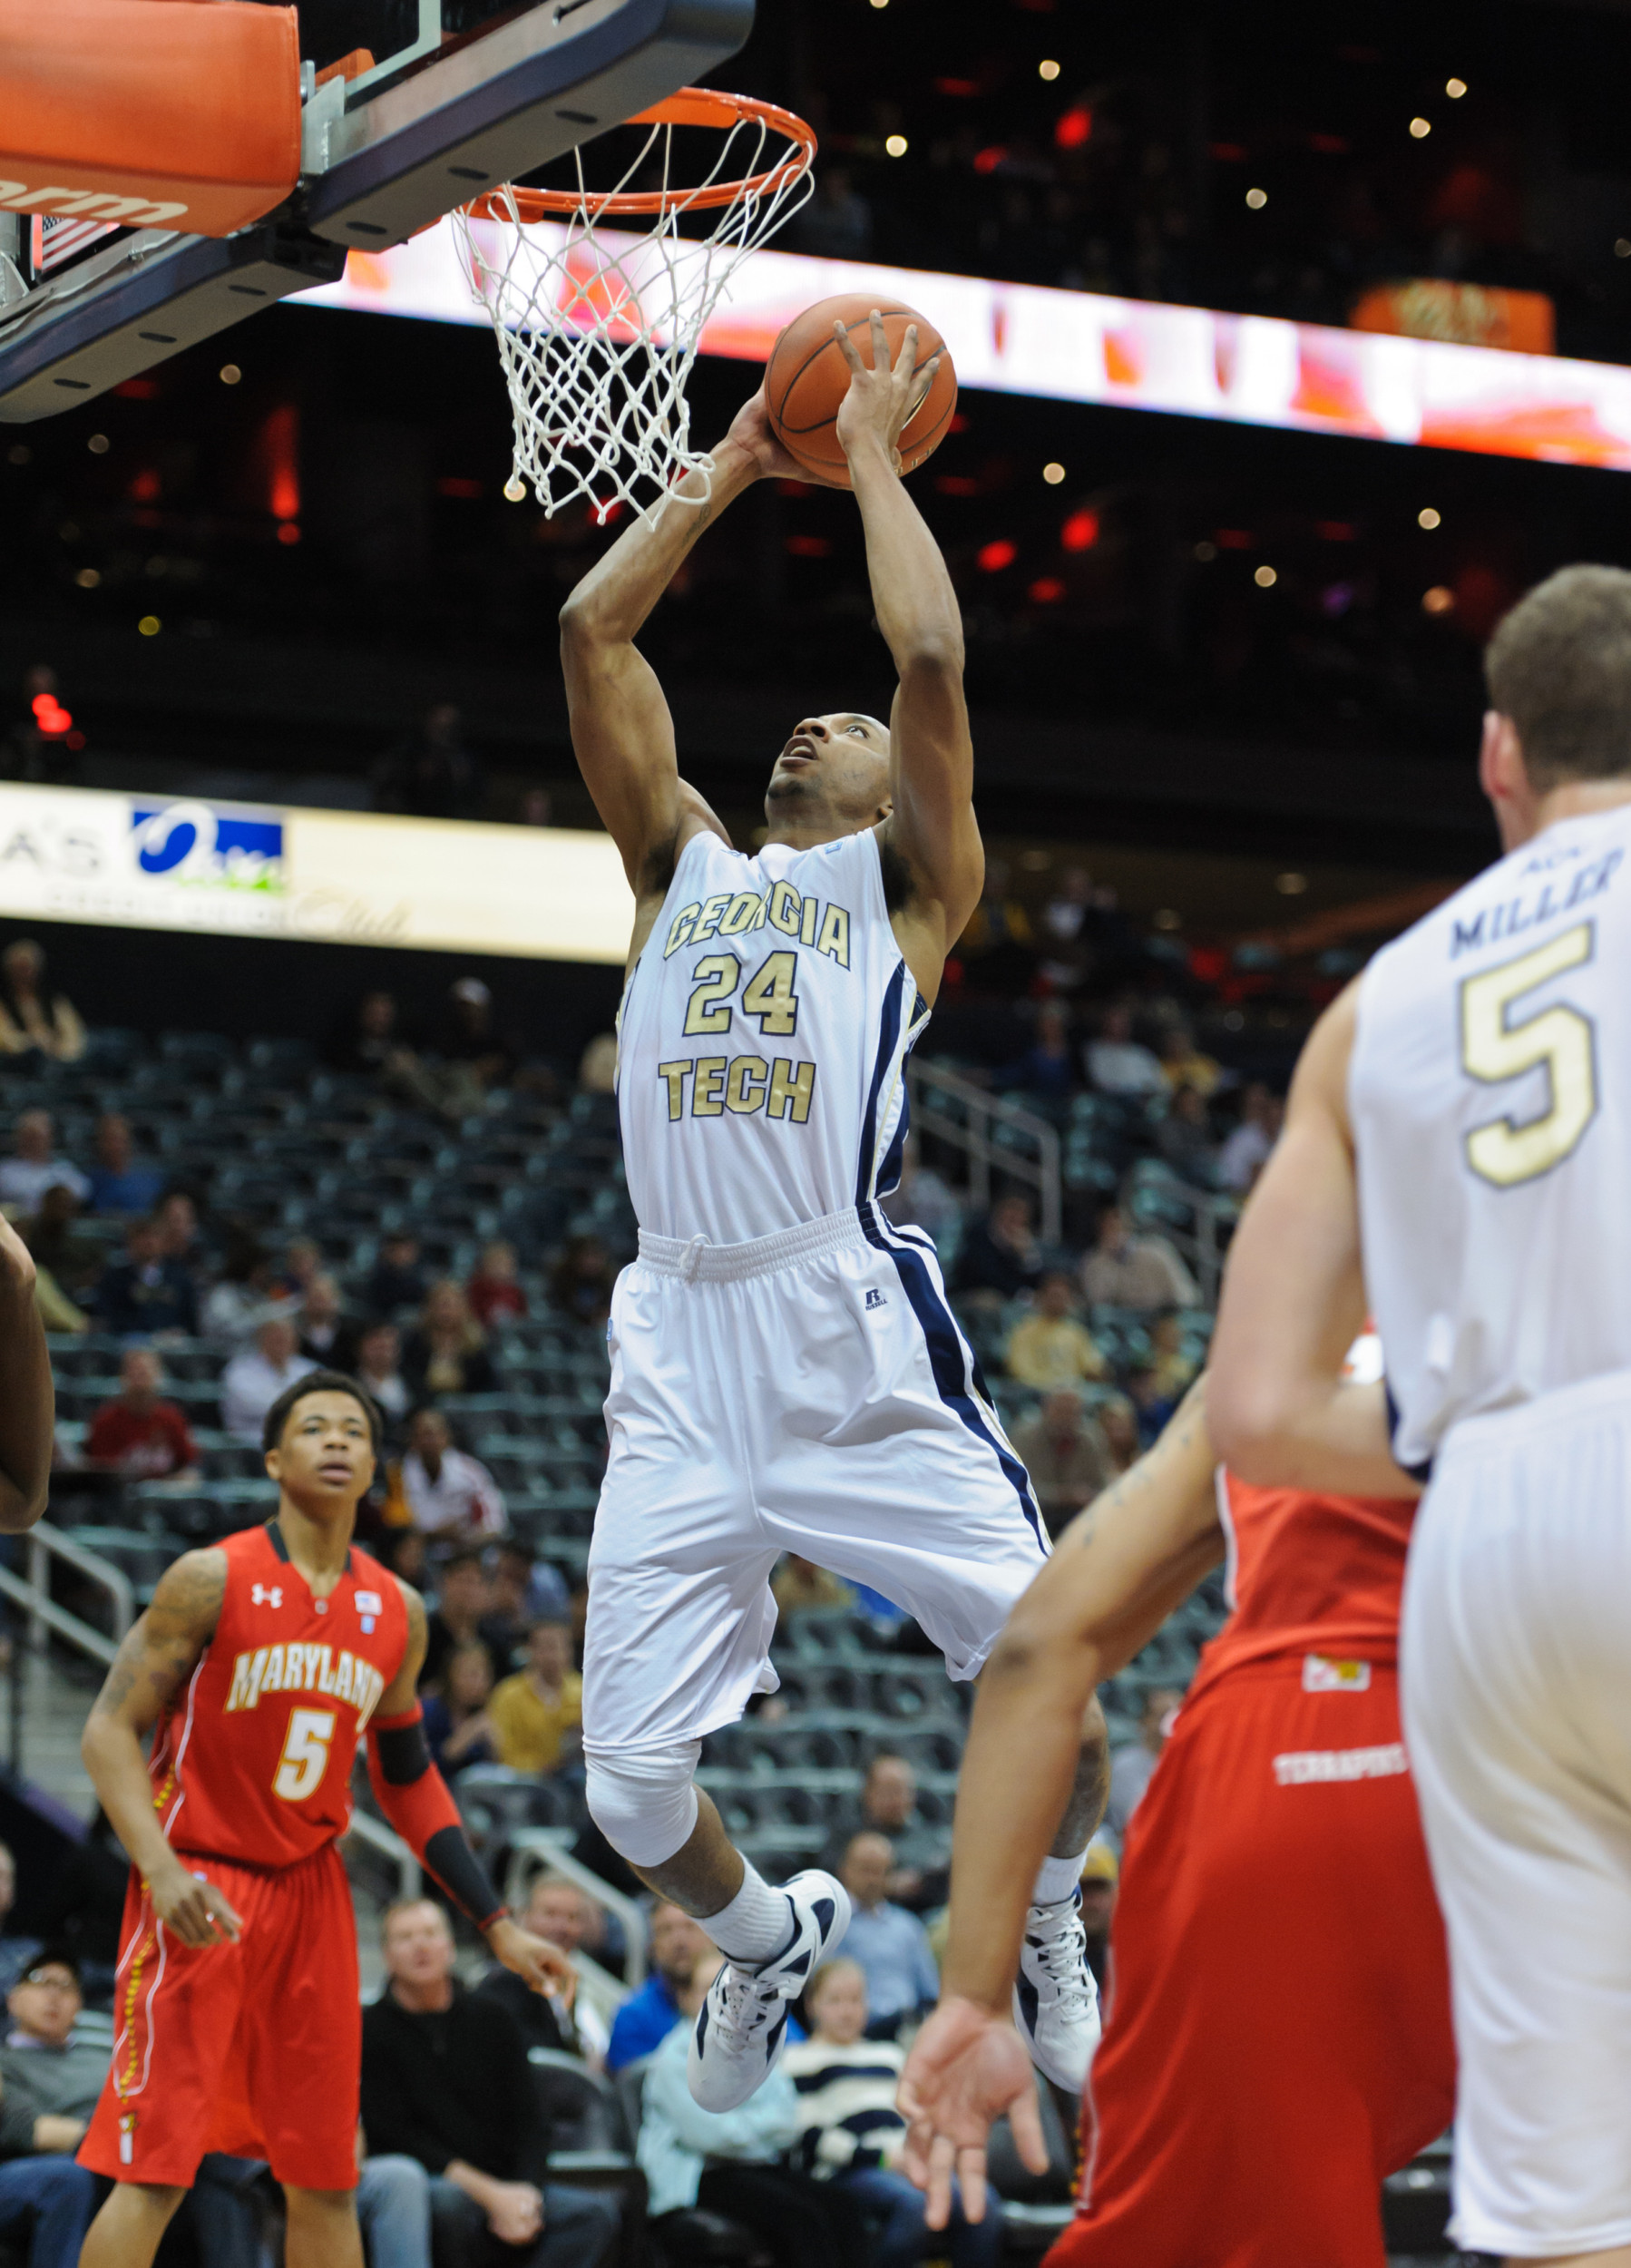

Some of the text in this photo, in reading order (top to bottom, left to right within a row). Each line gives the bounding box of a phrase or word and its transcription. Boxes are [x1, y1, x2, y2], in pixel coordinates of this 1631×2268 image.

[662, 878, 851, 972] GEORGIA
[1450, 847, 1625, 962] MILLER
[682, 950, 798, 1037] 24
[658, 1054, 816, 1124] TECH
[1459, 914, 1600, 1191] 5
[864, 1298, 888, 1312] RUSSELL
[223, 1639, 385, 1735] MARYLAND
[271, 1705, 338, 1802] 5
